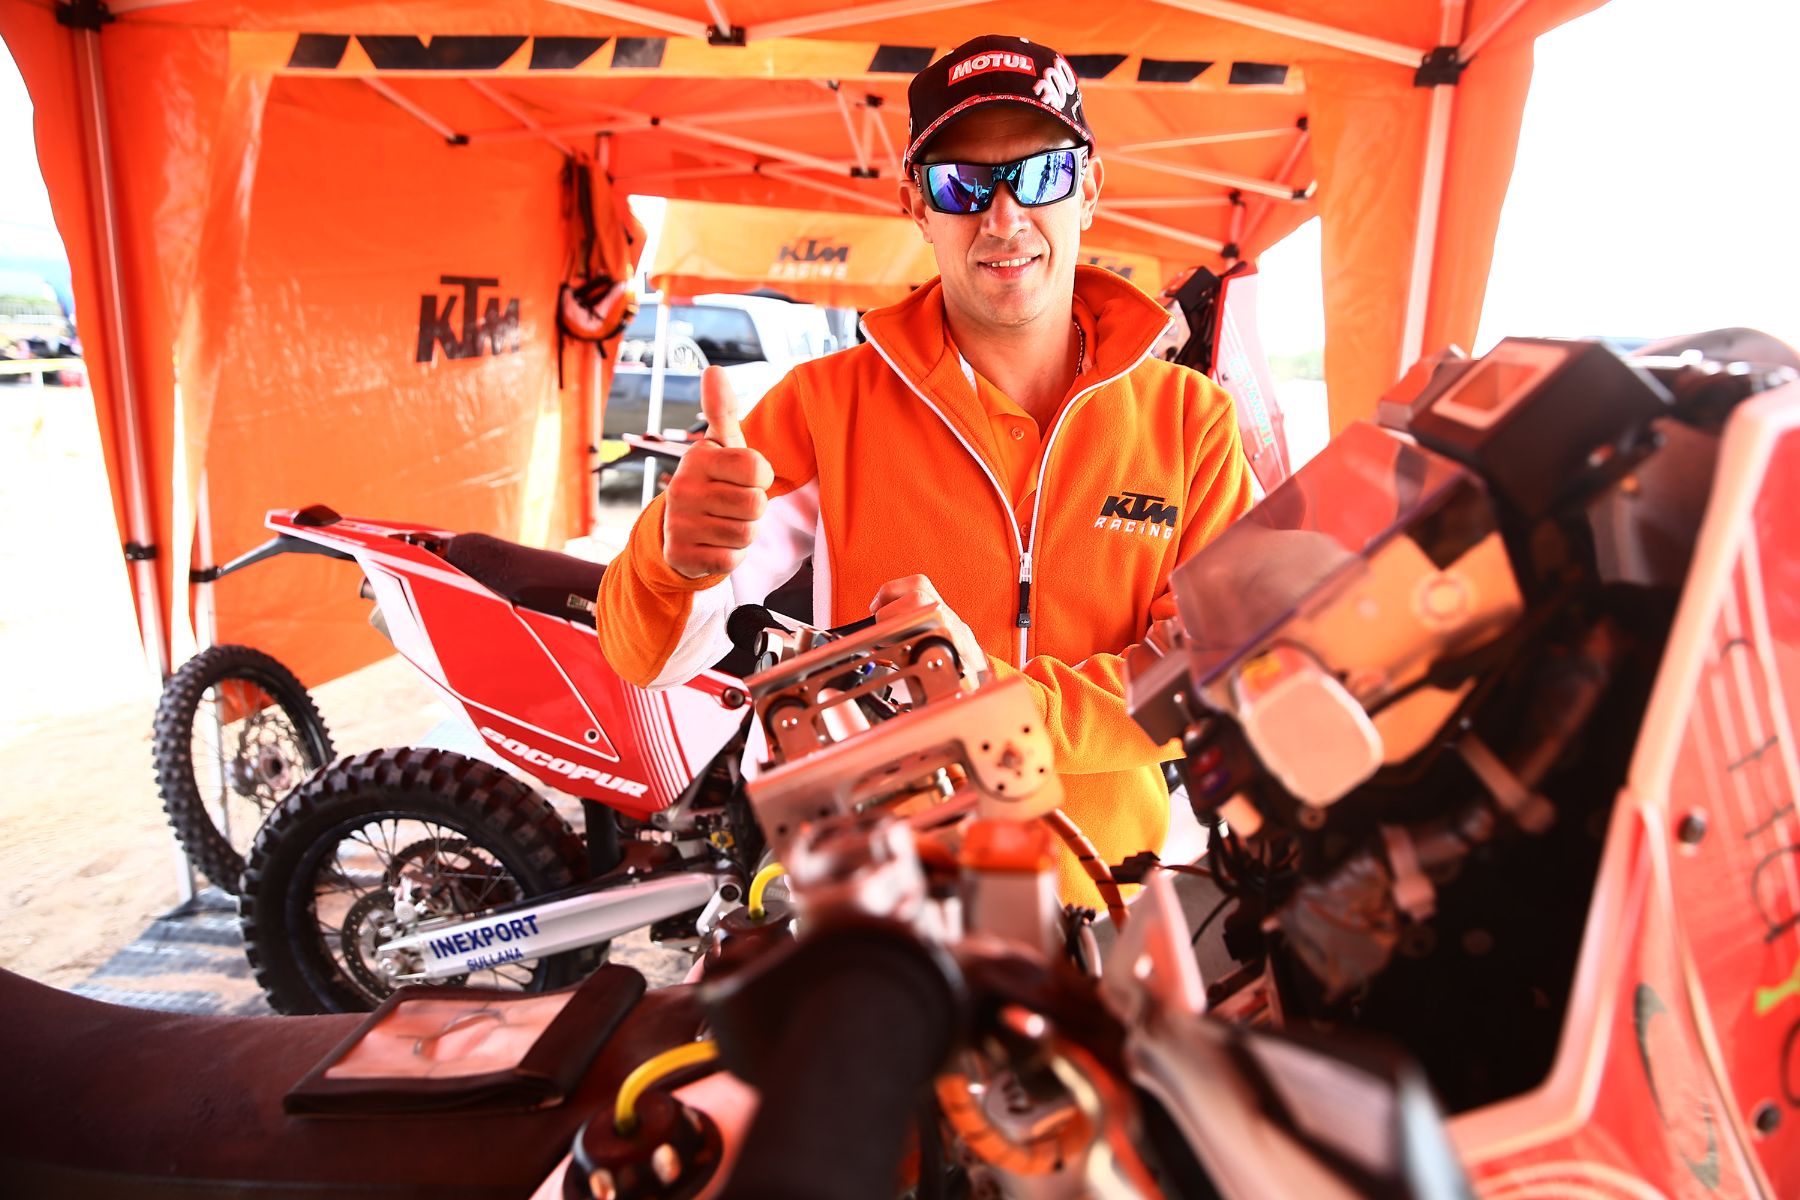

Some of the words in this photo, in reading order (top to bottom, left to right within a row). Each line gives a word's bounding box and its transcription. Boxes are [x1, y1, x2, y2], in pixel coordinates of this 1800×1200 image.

[951, 53, 1032, 81] MOTUL
[1018, 96, 1037, 105] MOTUL
[416, 275, 520, 363] KTM
[1099, 491, 1178, 528] KTM
[479, 726, 649, 798] SOCOPUR
[430, 914, 540, 959] INEXPORT
[466, 947, 524, 971] SULLANA
